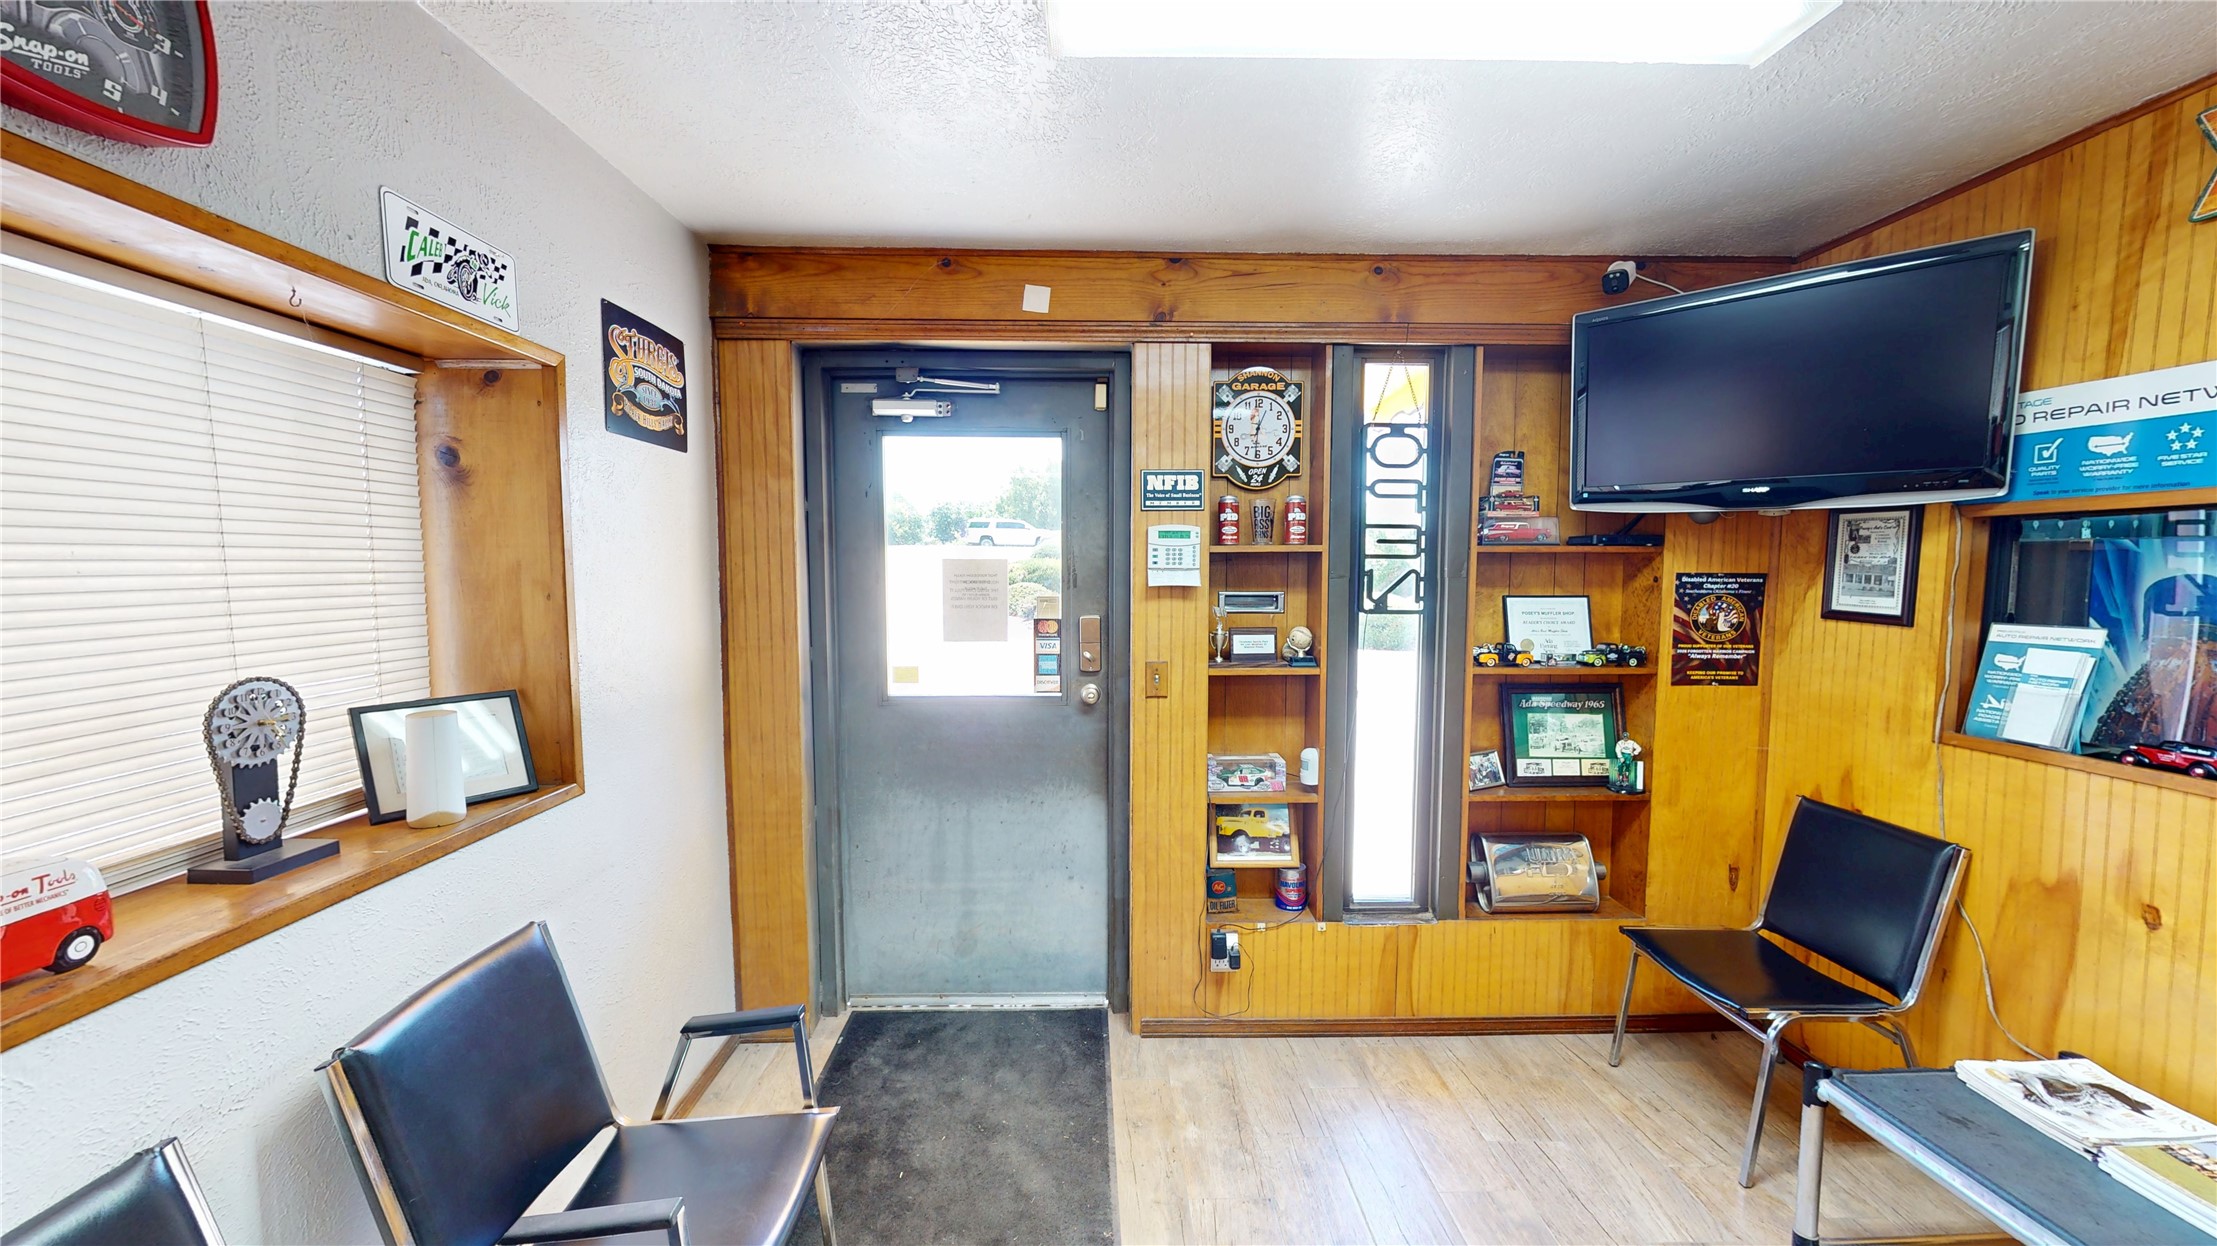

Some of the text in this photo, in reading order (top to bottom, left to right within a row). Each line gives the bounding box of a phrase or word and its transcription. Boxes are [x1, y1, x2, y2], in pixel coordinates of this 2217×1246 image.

[0, 21, 89, 66] Snap-on
[153, 33, 172, 55] 3
[31, 57, 83, 79] TOOLS
[103, 78, 123, 102] 5
[150, 85, 168, 106] 4
[406, 229, 444, 262] CALEB
[482, 282, 511, 318] Vick
[1237, 371, 1281, 382] SHANNON
[634, 367, 683, 400] SOUTH DAKOTA
[1231, 383, 1286, 391] GARAGE
[1254, 399, 1263, 408] 12
[1269, 402, 1273, 411] 1
[1277, 411, 1282, 420] 2
[2033, 399, 2130, 423] REPAIR
[1229, 425, 1234, 434] 9
[1282, 424, 1287, 433] 3
[1234, 438, 1239, 447] 8
[1276, 438, 1282, 446] 4
[1245, 446, 1249, 455] 7
[1268, 446, 1273, 455] 5
[2081, 456, 2137, 466] NATIONWIDE
[2161, 458, 2205, 467] SERVICE
[2028, 465, 2060, 473] QUALITY
[2079, 462, 2139, 472] WORRY-FREE
[2082, 469, 2134, 477] WARRANTY
[1147, 475, 1199, 490] NFIB
[2095, 485, 2120, 494] provider
[2151, 481, 2190, 489] information
[1253, 506, 1271, 518] BIG
[1254, 518, 1270, 530] ASS
[1692, 596, 1745, 621] DISABLED AMERICAN
[1698, 630, 1736, 641] VETERANS
[2050, 636, 2096, 644] NETWORK
[1519, 699, 1605, 711] Ada Speedway 1965
[31, 869, 76, 894] Tools
[1213, 883, 1224, 891] AC
[1280, 880, 1305, 888] HAVOLIN
[13, 900, 35, 912] BETTER
[36, 891, 68, 904] MECHANICS
[1209, 900, 1235, 911] OIL FILTER
